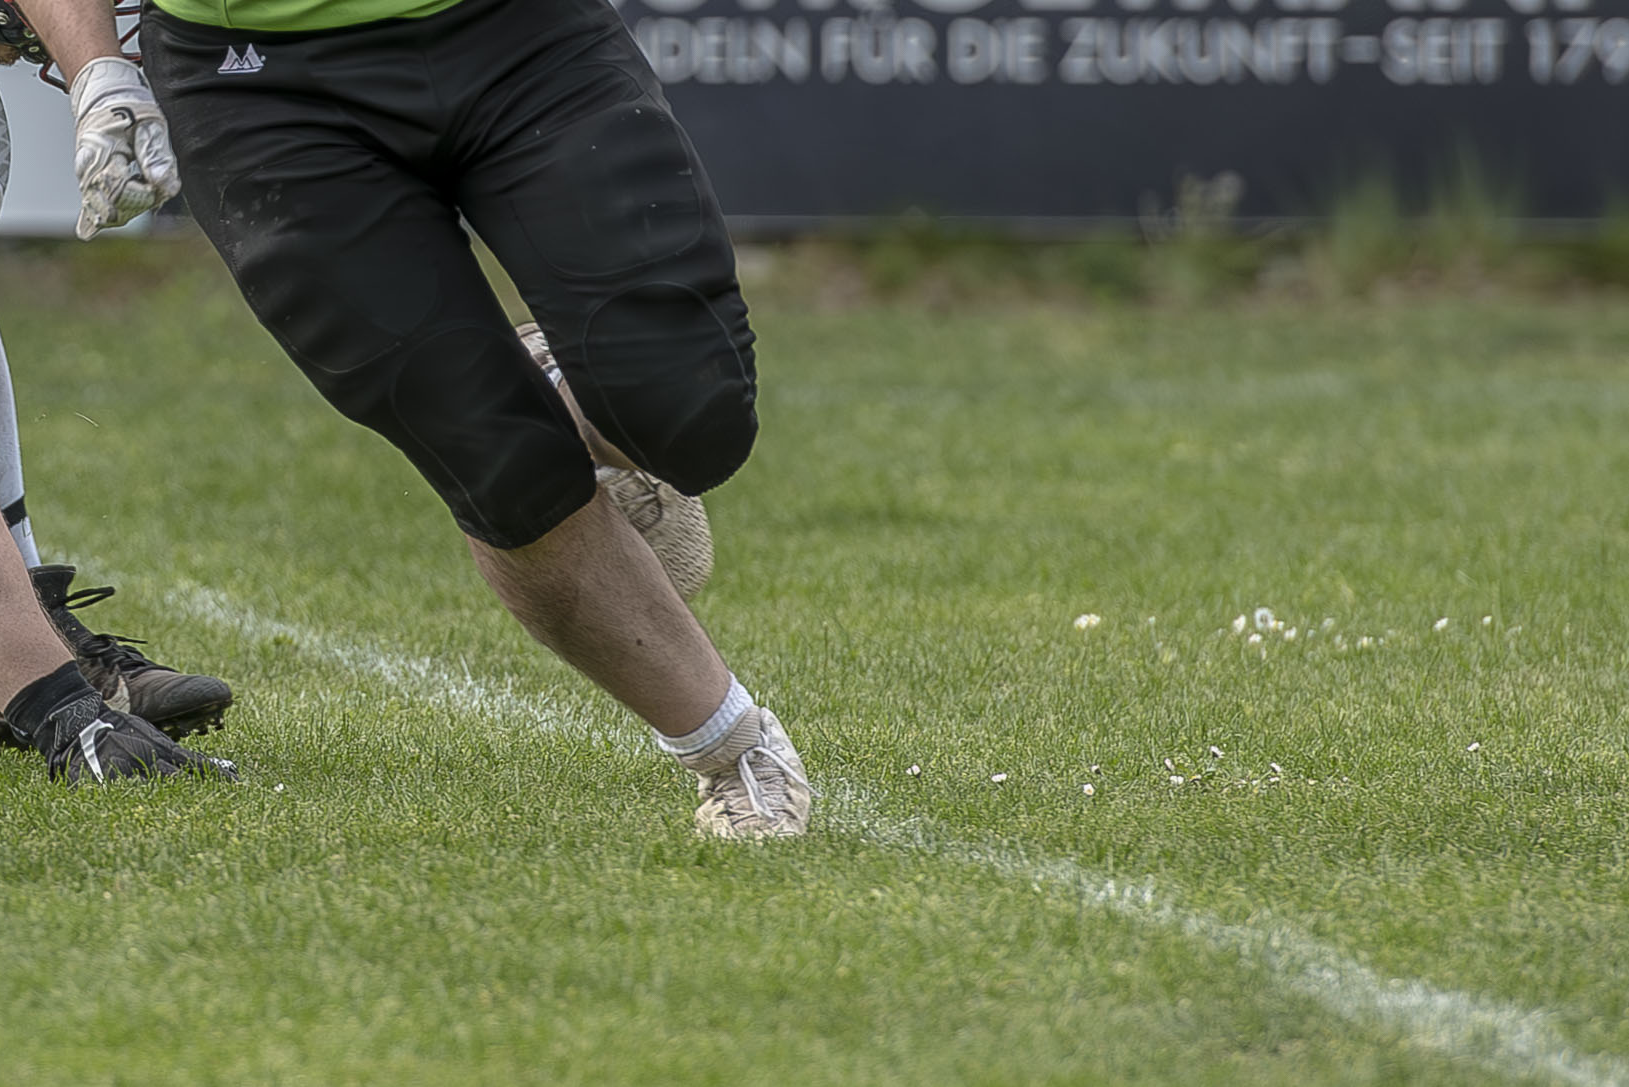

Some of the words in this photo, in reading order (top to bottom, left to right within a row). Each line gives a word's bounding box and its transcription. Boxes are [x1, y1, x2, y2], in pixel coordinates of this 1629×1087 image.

[635, 16, 812, 84] DELN
[821, 4, 938, 84] FÜR
[946, 16, 1053, 84] DIE
